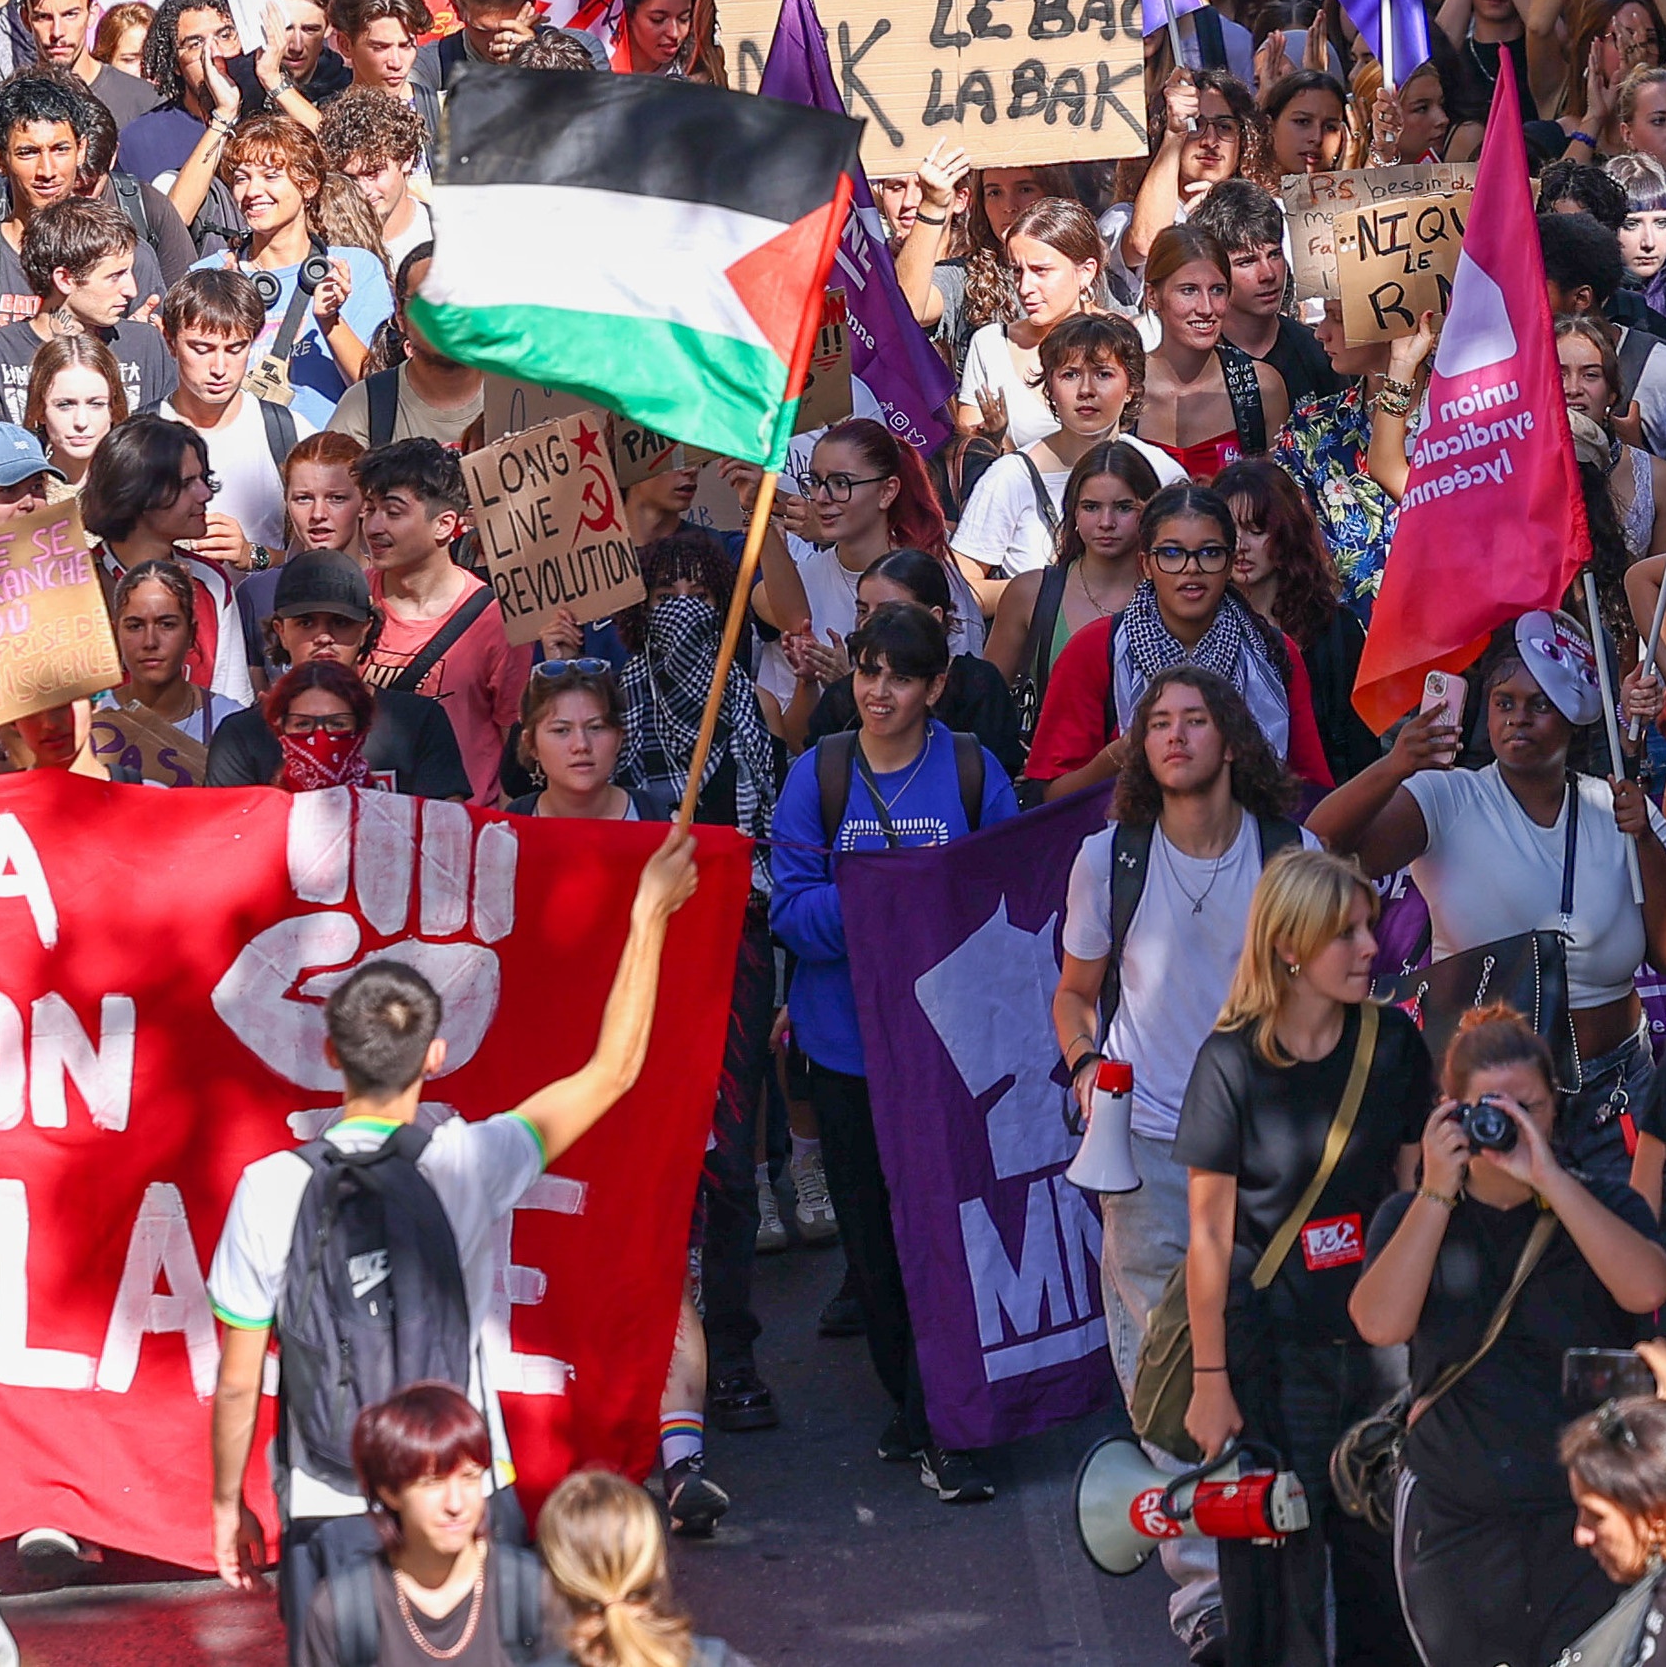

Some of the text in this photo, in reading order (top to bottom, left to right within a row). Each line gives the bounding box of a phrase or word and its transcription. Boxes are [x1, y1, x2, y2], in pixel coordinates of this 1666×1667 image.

[921, 57, 1148, 146] LA BAK
[1363, 174, 1442, 200] besoin
[1402, 249, 1433, 274] LE
[471, 434, 569, 508] LONG
[30, 518, 76, 564] SE
[486, 496, 560, 560] LIVE
[493, 537, 641, 624] REVOLUTION
